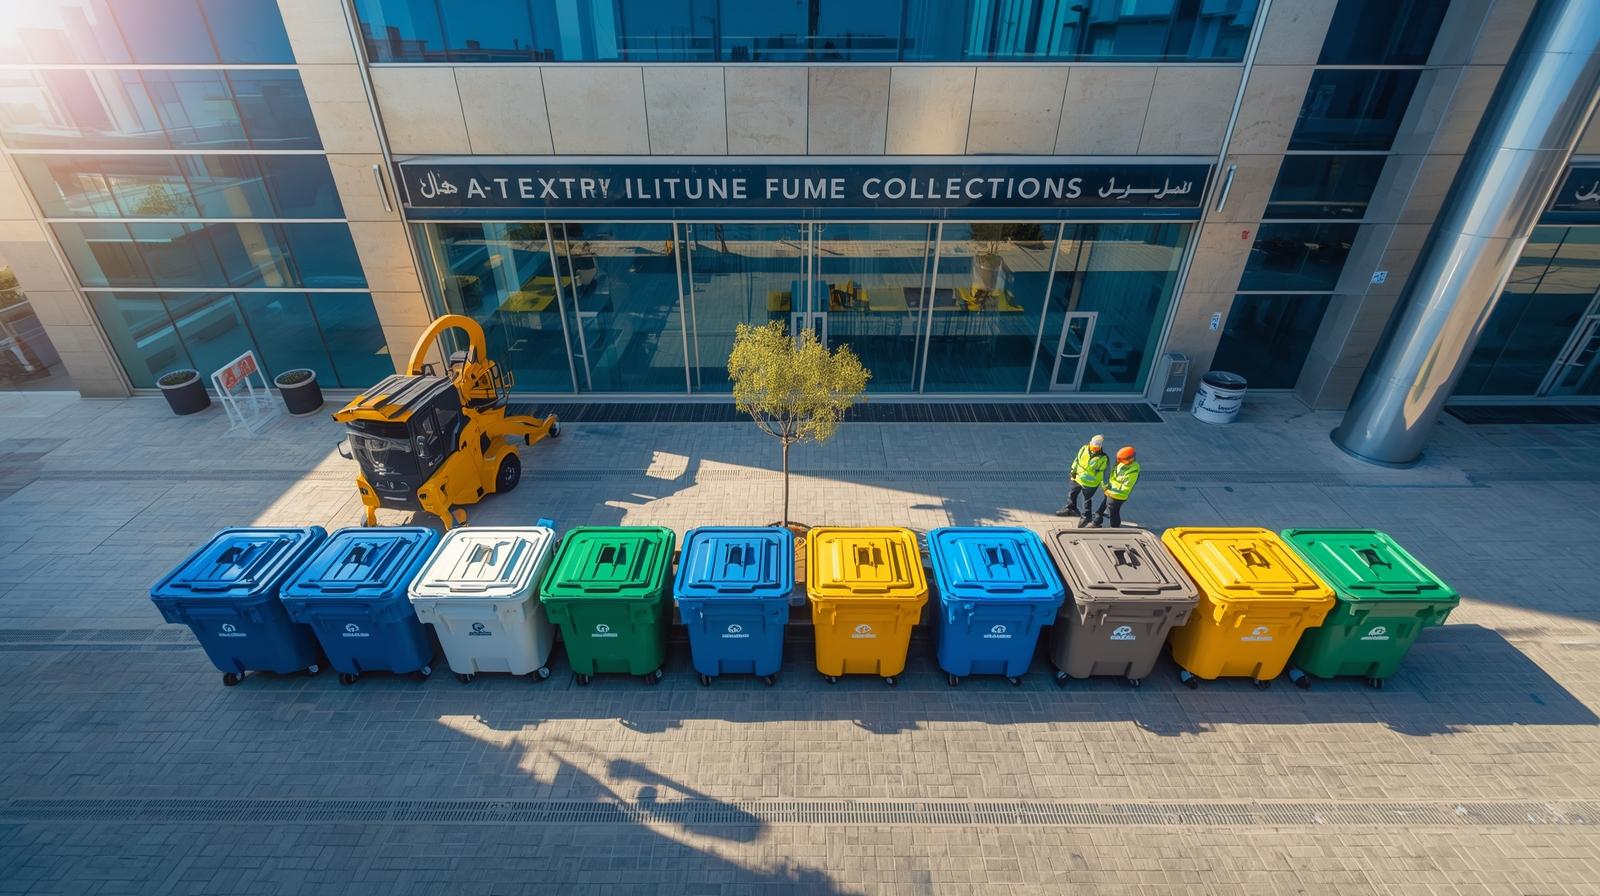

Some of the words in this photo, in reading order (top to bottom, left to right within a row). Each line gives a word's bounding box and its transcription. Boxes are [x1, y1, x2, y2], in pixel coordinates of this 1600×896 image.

[625, 178, 747, 199] ILITUNE
[765, 178, 845, 199] FUME
[862, 177, 1083, 199] COLLECTIONS
